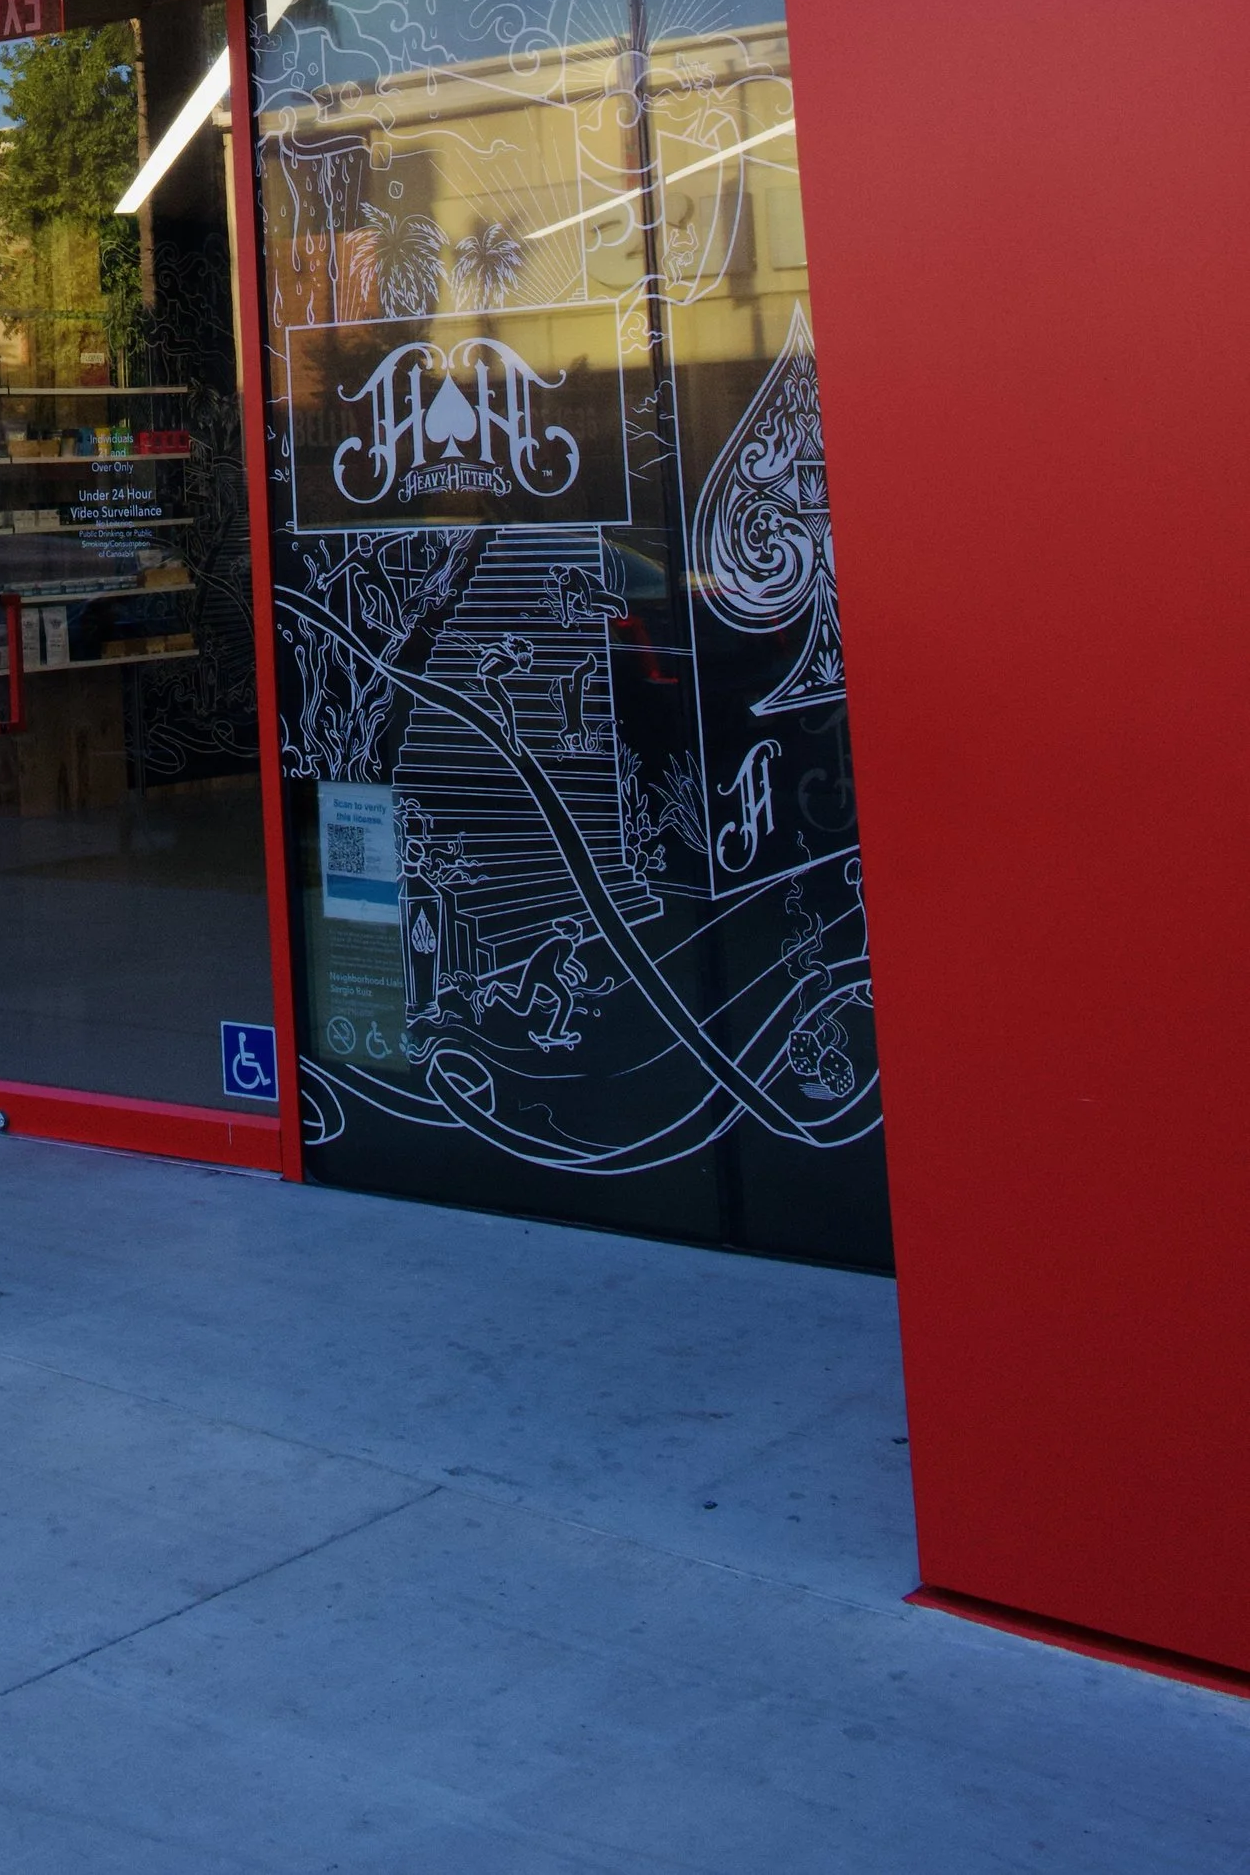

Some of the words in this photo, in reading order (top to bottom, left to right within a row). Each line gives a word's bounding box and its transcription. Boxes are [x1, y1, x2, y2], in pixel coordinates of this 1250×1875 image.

[90, 434, 134, 444] Individuals
[110, 448, 126, 458] and
[91, 462, 112, 472] Over
[114, 462, 134, 474] Only
[78, 489, 109, 502] Under
[112, 489, 124, 501] 24
[127, 488, 152, 500] Hour
[70, 507, 99, 519] Video
[101, 505, 162, 518] Surveillance
[133, 529, 152, 537] Public
[333, 798, 352, 809] Scan
[354, 801, 362, 810] to
[364, 803, 386, 815] verify
[336, 812, 351, 822] this
[330, 972, 384, 986] Neighborhood
[330, 984, 354, 997] Sergio
